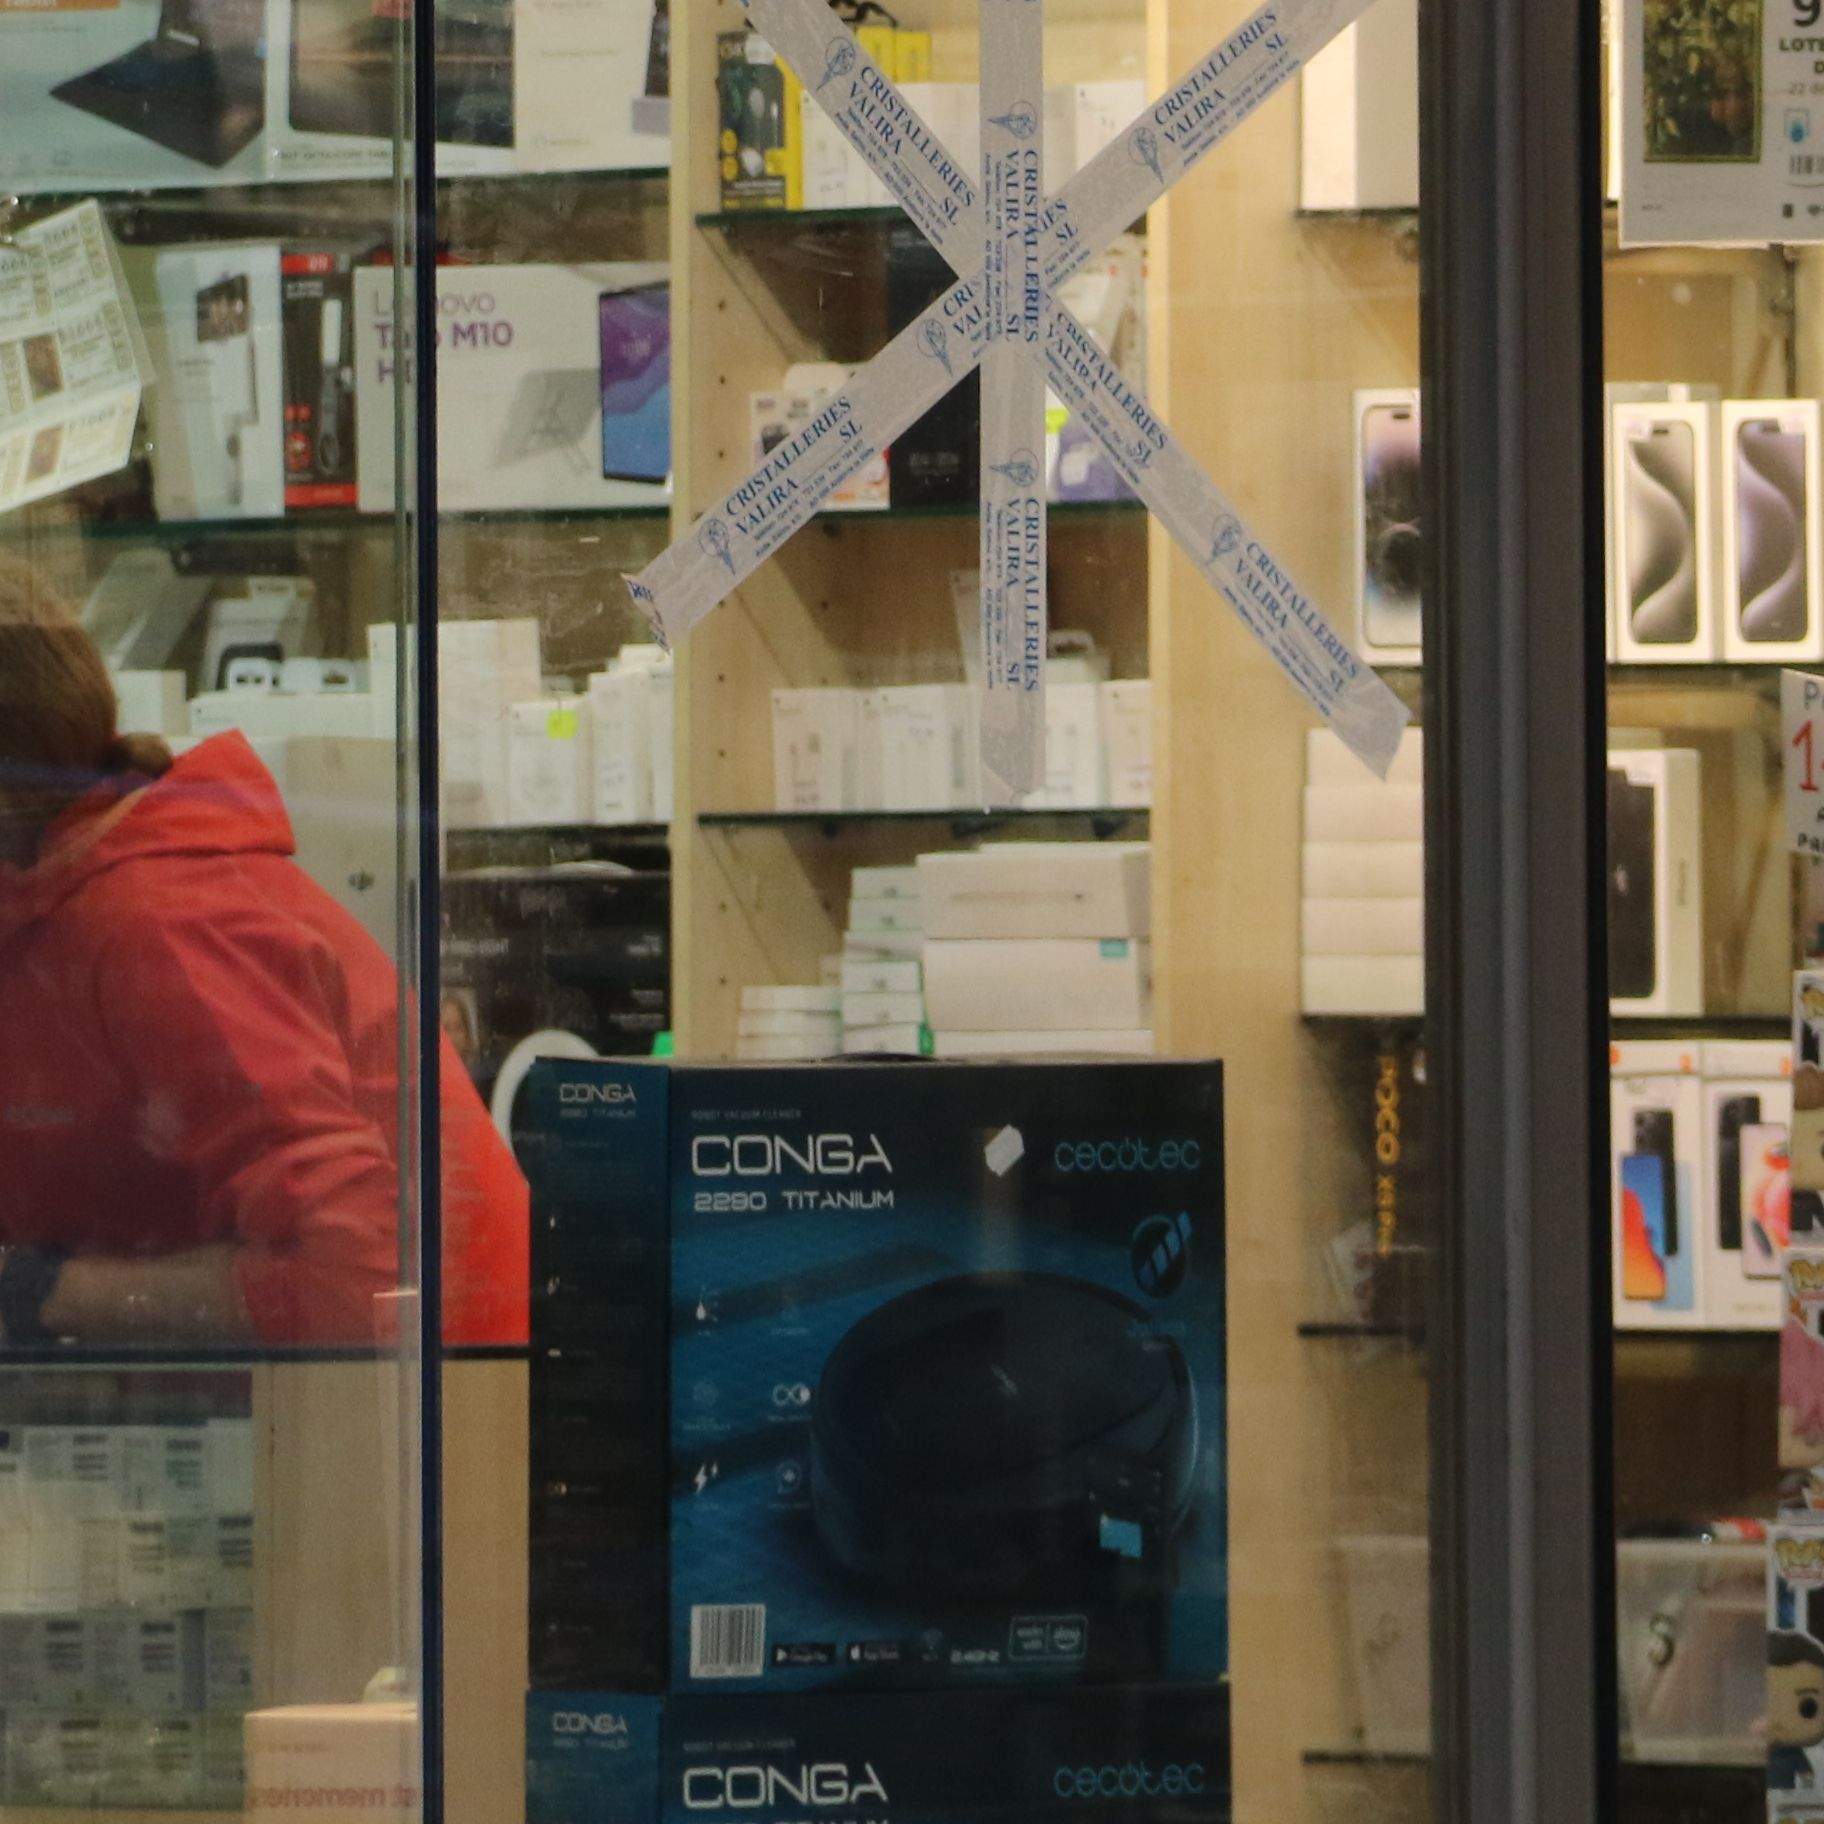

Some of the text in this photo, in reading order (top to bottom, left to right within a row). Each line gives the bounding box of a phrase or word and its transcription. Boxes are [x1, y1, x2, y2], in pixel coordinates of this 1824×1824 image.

[1150, 10, 1278, 127] CRISTALLERIES
[841, 79, 908, 155] VALIRA
[856, 64, 978, 207] CRISTALLERIES
[1163, 87, 1225, 145] VALIRA
[450, 321, 515, 349] M10
[721, 396, 853, 517] CRISTALLERIES
[733, 476, 798, 536] VALIRA
[1006, 498, 1020, 587] VALIRA
[1024, 497, 1039, 690] CRISTALLERIES
[559, 1083, 637, 1102] CONGA
[691, 1133, 894, 1177] CONGA
[781, 1188, 895, 1210] TITANIUM
[682, 1762, 889, 1810] CONGA
